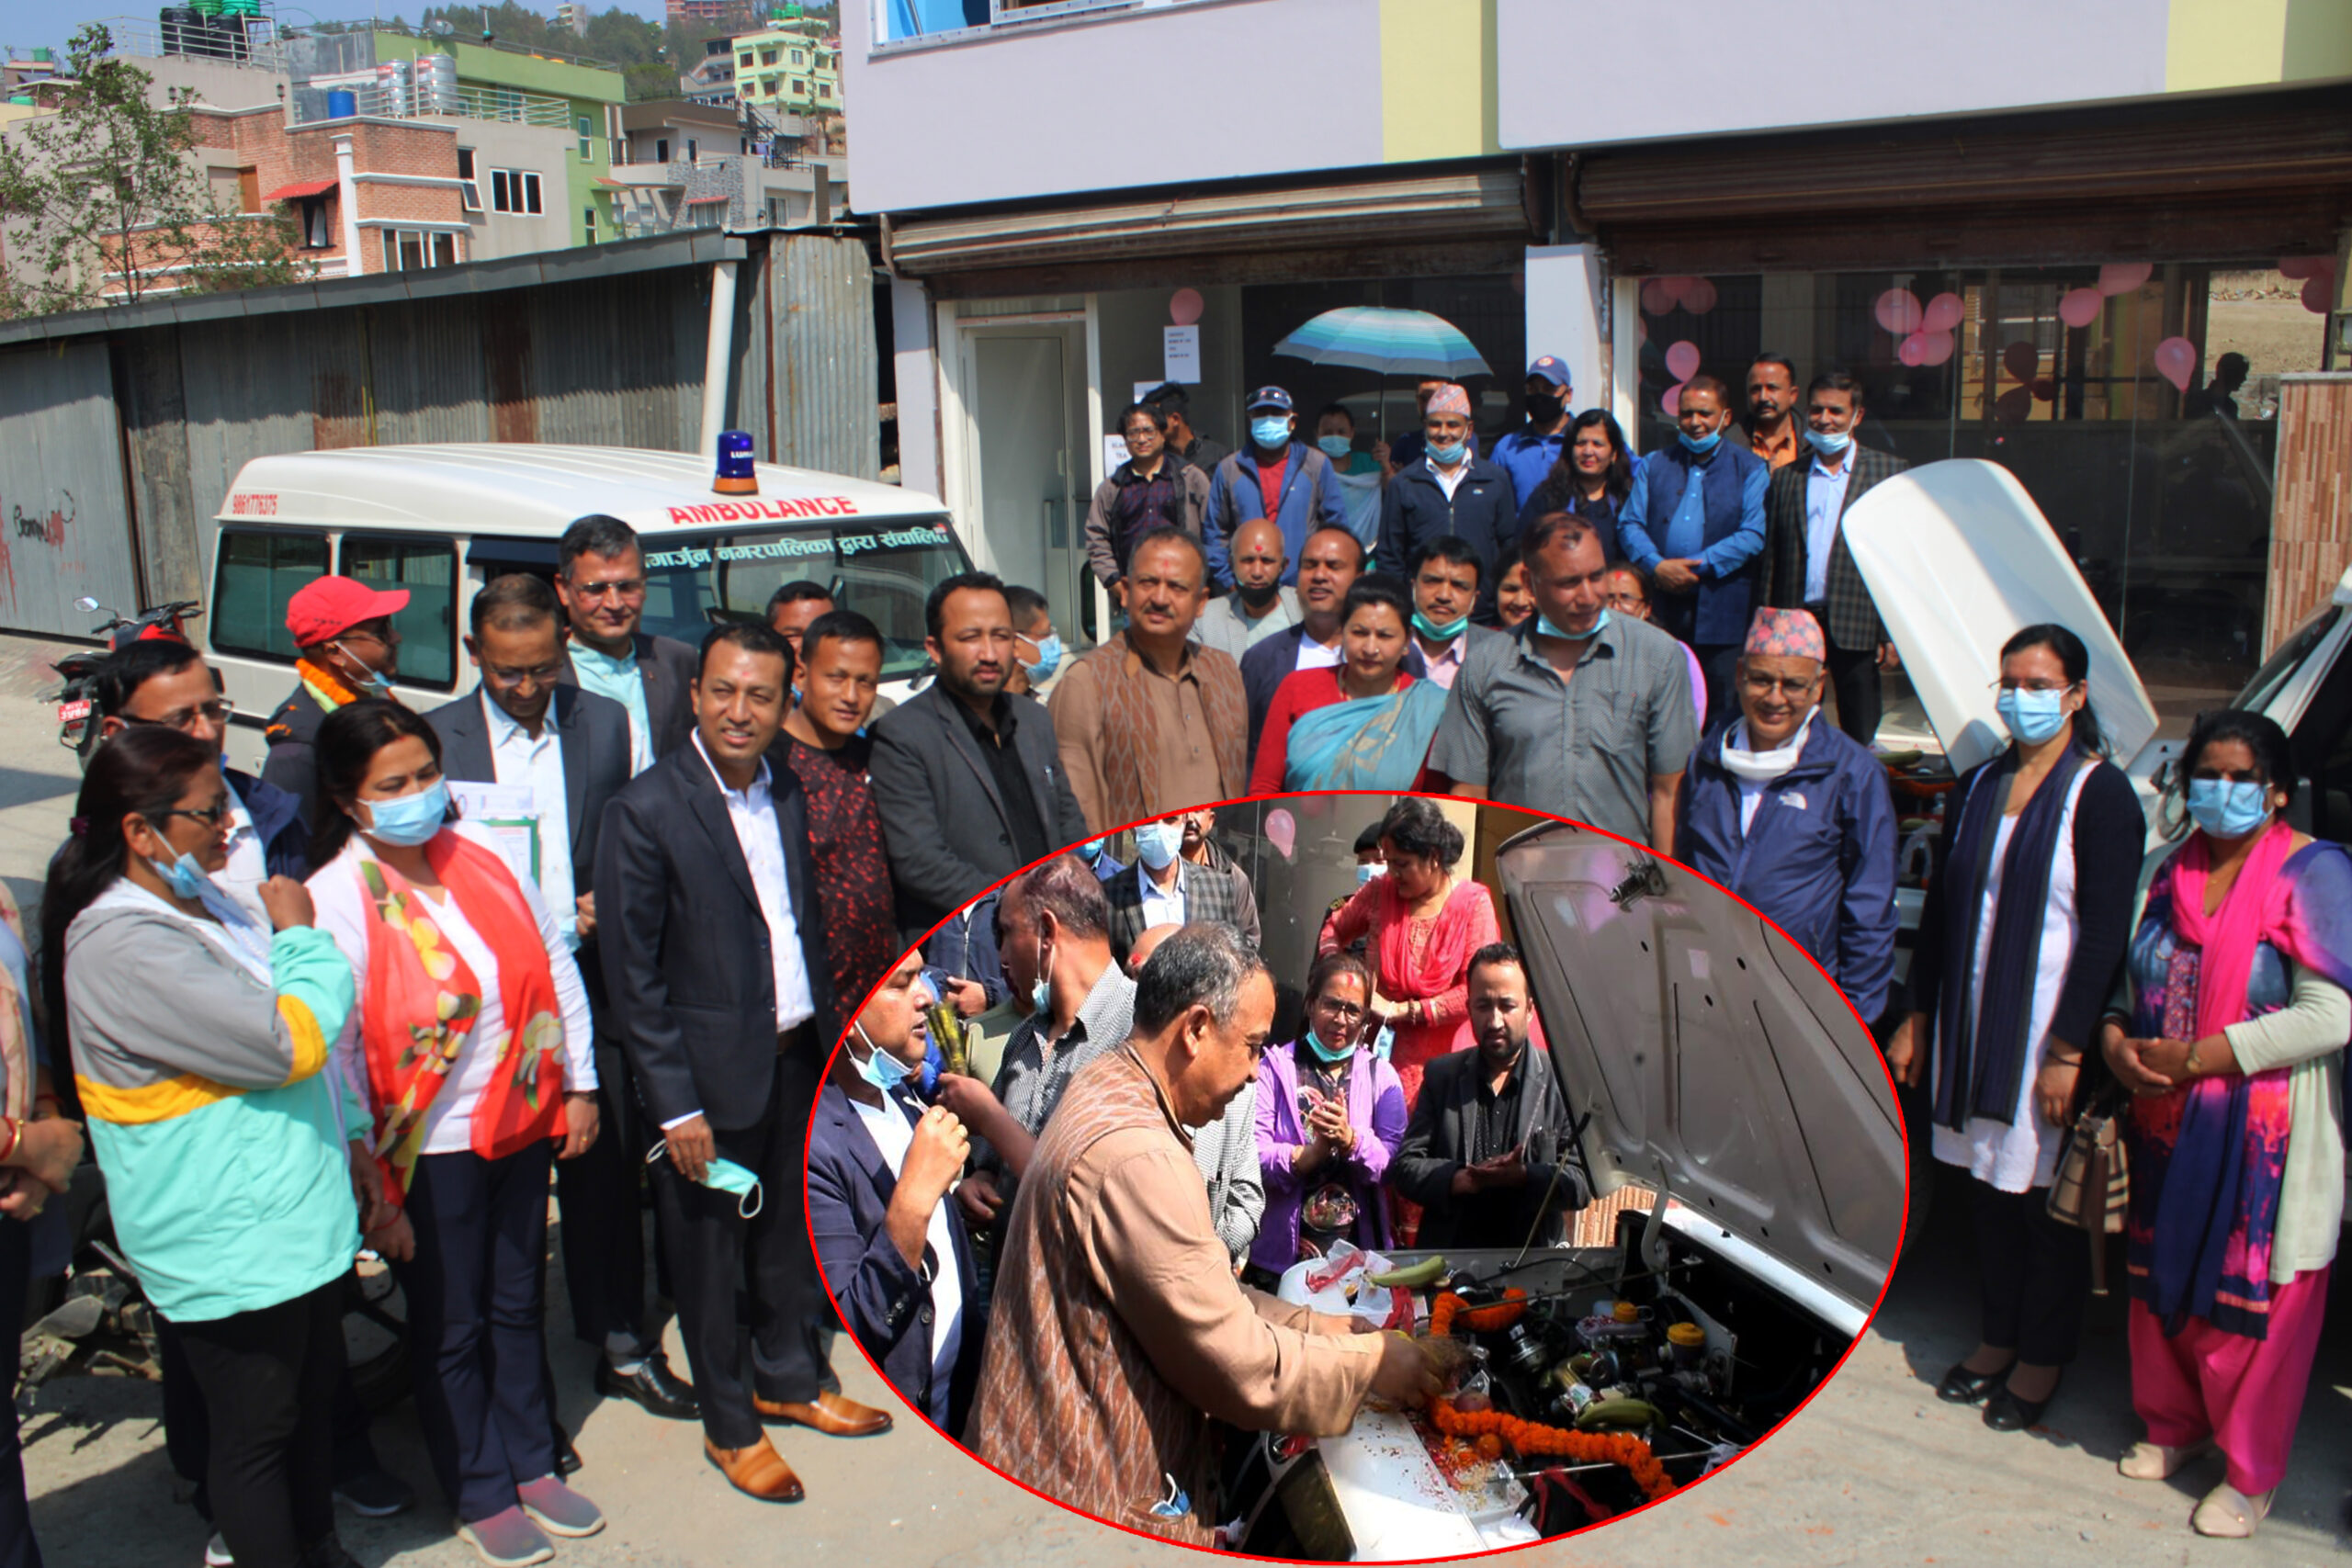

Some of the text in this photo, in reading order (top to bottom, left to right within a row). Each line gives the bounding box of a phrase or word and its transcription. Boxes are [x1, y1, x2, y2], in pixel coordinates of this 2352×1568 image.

[667, 496, 858, 525] AMBULANCE
[645, 547, 712, 569] गार्जुन
[714, 537, 834, 561] नगरपालिका
[836, 535, 877, 555] द्वारा
